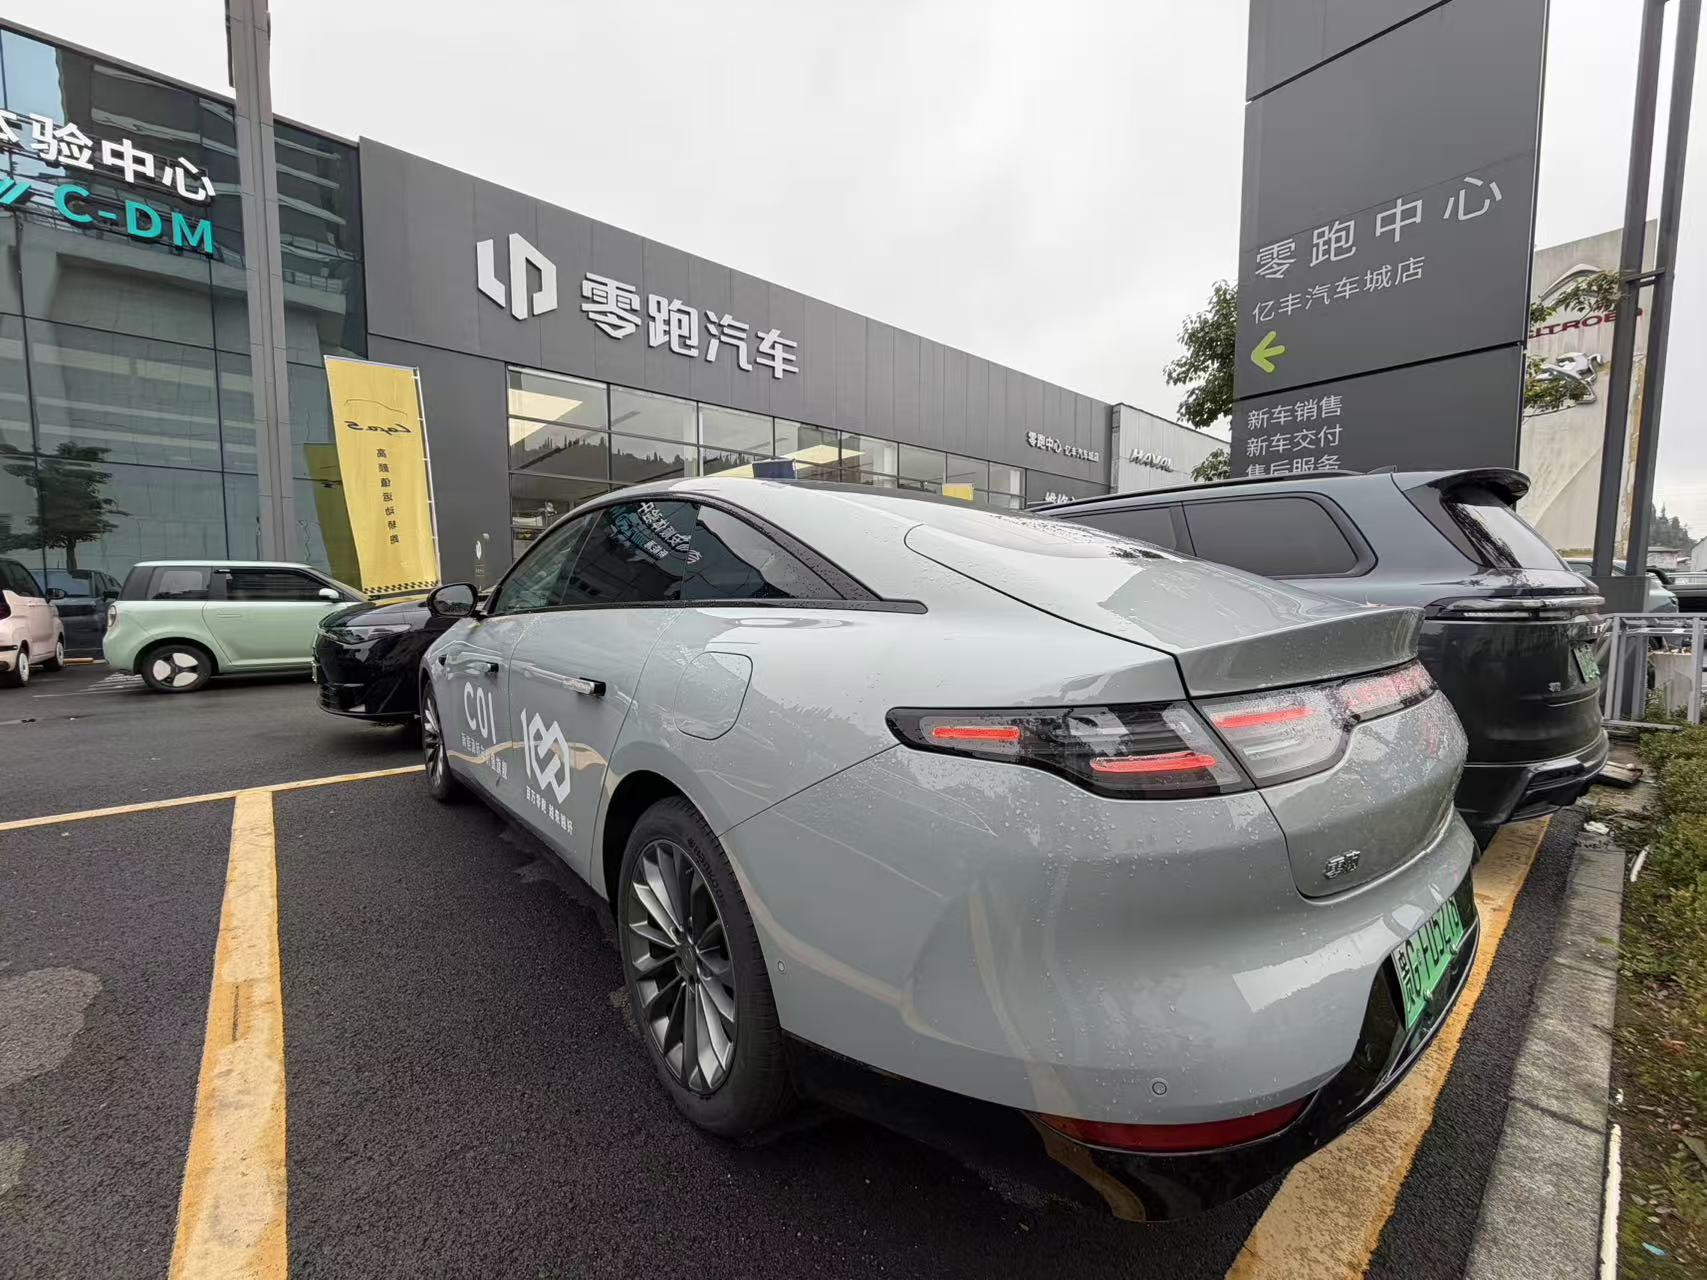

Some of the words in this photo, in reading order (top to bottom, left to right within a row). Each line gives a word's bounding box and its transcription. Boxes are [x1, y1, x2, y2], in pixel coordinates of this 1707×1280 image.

[54, 183, 214, 254] C-DM
[1254, 174, 1503, 281] 零跑中心
[1252, 256, 1426, 325] 亿丰汽车城店
[580, 271, 800, 380] 零跑汽车
[1247, 394, 1343, 431] 新车销售
[1027, 431, 1062, 454] 零跑中心
[1246, 423, 1344, 458] 新车交付
[1130, 447, 1174, 472] HAVAL
[1246, 454, 1342, 479] 售后服务
